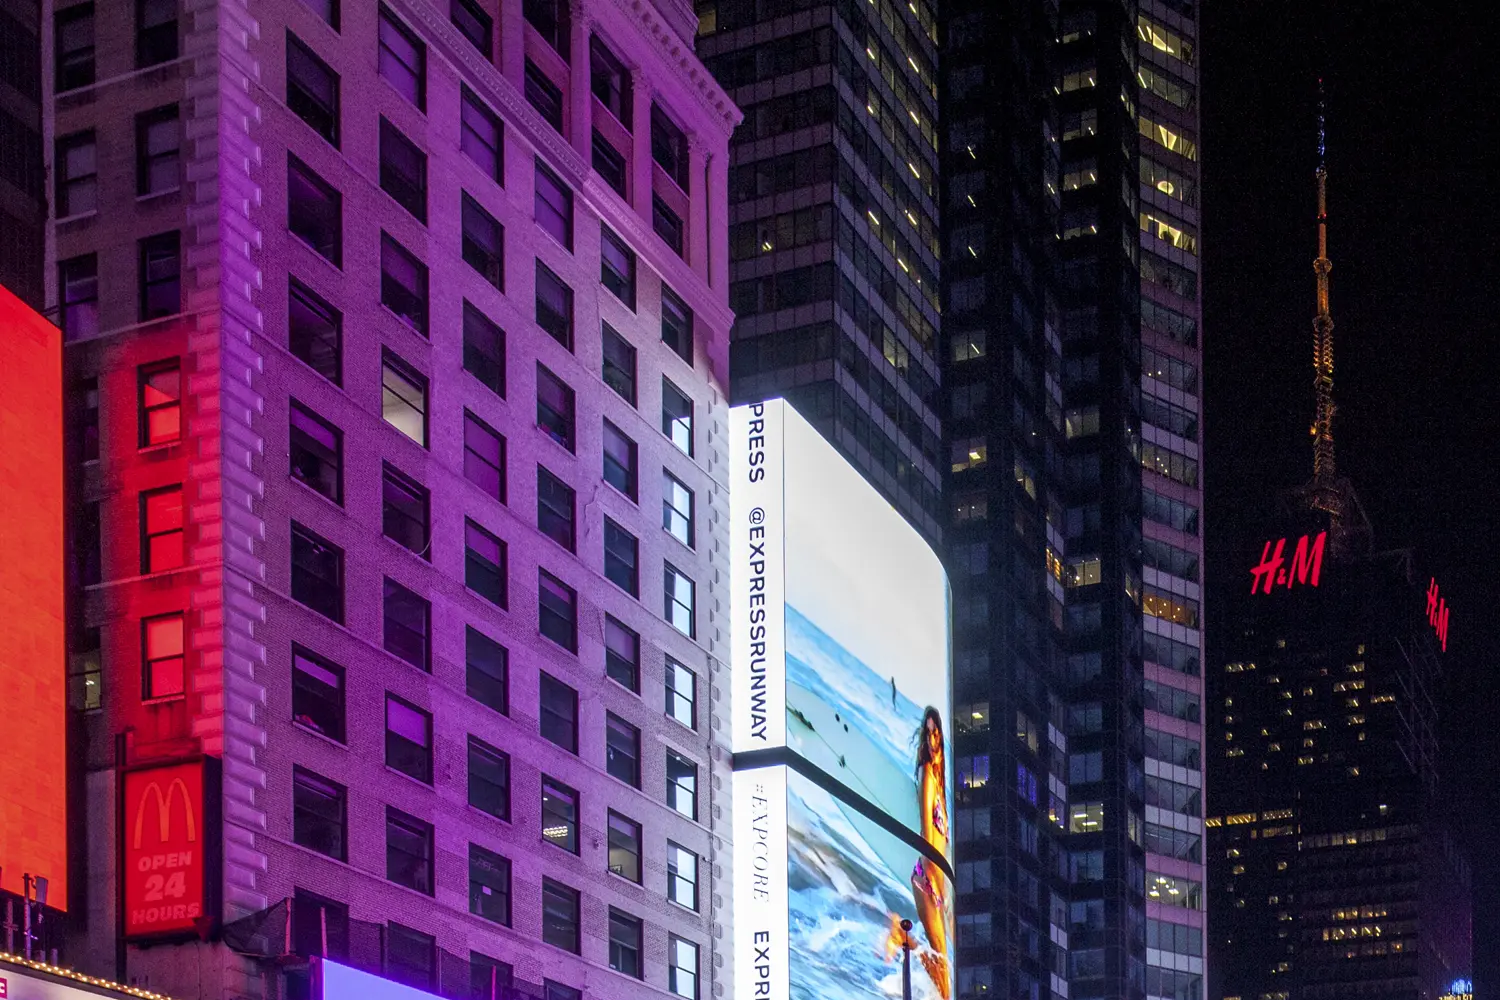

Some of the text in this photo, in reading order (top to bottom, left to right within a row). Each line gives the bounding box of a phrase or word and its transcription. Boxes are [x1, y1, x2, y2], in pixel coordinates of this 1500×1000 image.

[1250, 531, 1327, 595] H&M
[748, 507, 767, 741] @EXPRESSRUNWAY
[1426, 577, 1449, 652] H&M
[138, 851, 192, 872] OPEN
[144, 872, 186, 902] 24
[132, 903, 199, 924] HOURS
